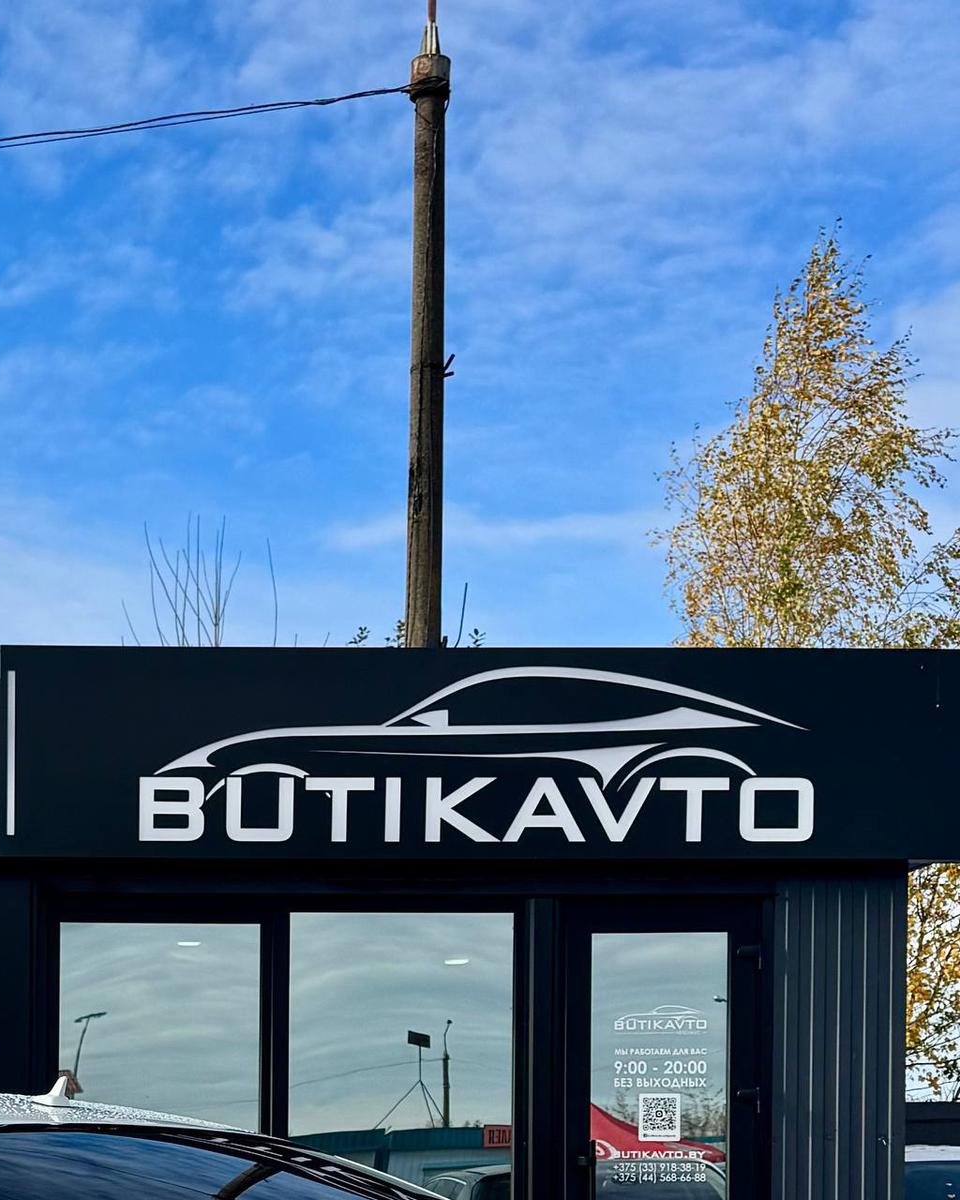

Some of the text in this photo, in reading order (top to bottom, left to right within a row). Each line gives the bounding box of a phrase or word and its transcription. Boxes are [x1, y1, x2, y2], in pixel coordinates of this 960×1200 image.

[138, 776, 814, 843] BUTIKAVTO
[613, 1019, 707, 1031] BUTIKAVTO
[614, 1047, 708, 1057] МЫ РАБОТАЕМ ДЛЯ ВАС
[614, 1061, 647, 1075] 9:00
[663, 1061, 708, 1075] 20:00
[614, 1078, 707, 1089] БЕЗ ВЫХОДНЫХ
[613, 1162, 706, 1174] +375 (33) 918-38-19
[613, 1172, 707, 1184] +375 (44) 568-66-88
